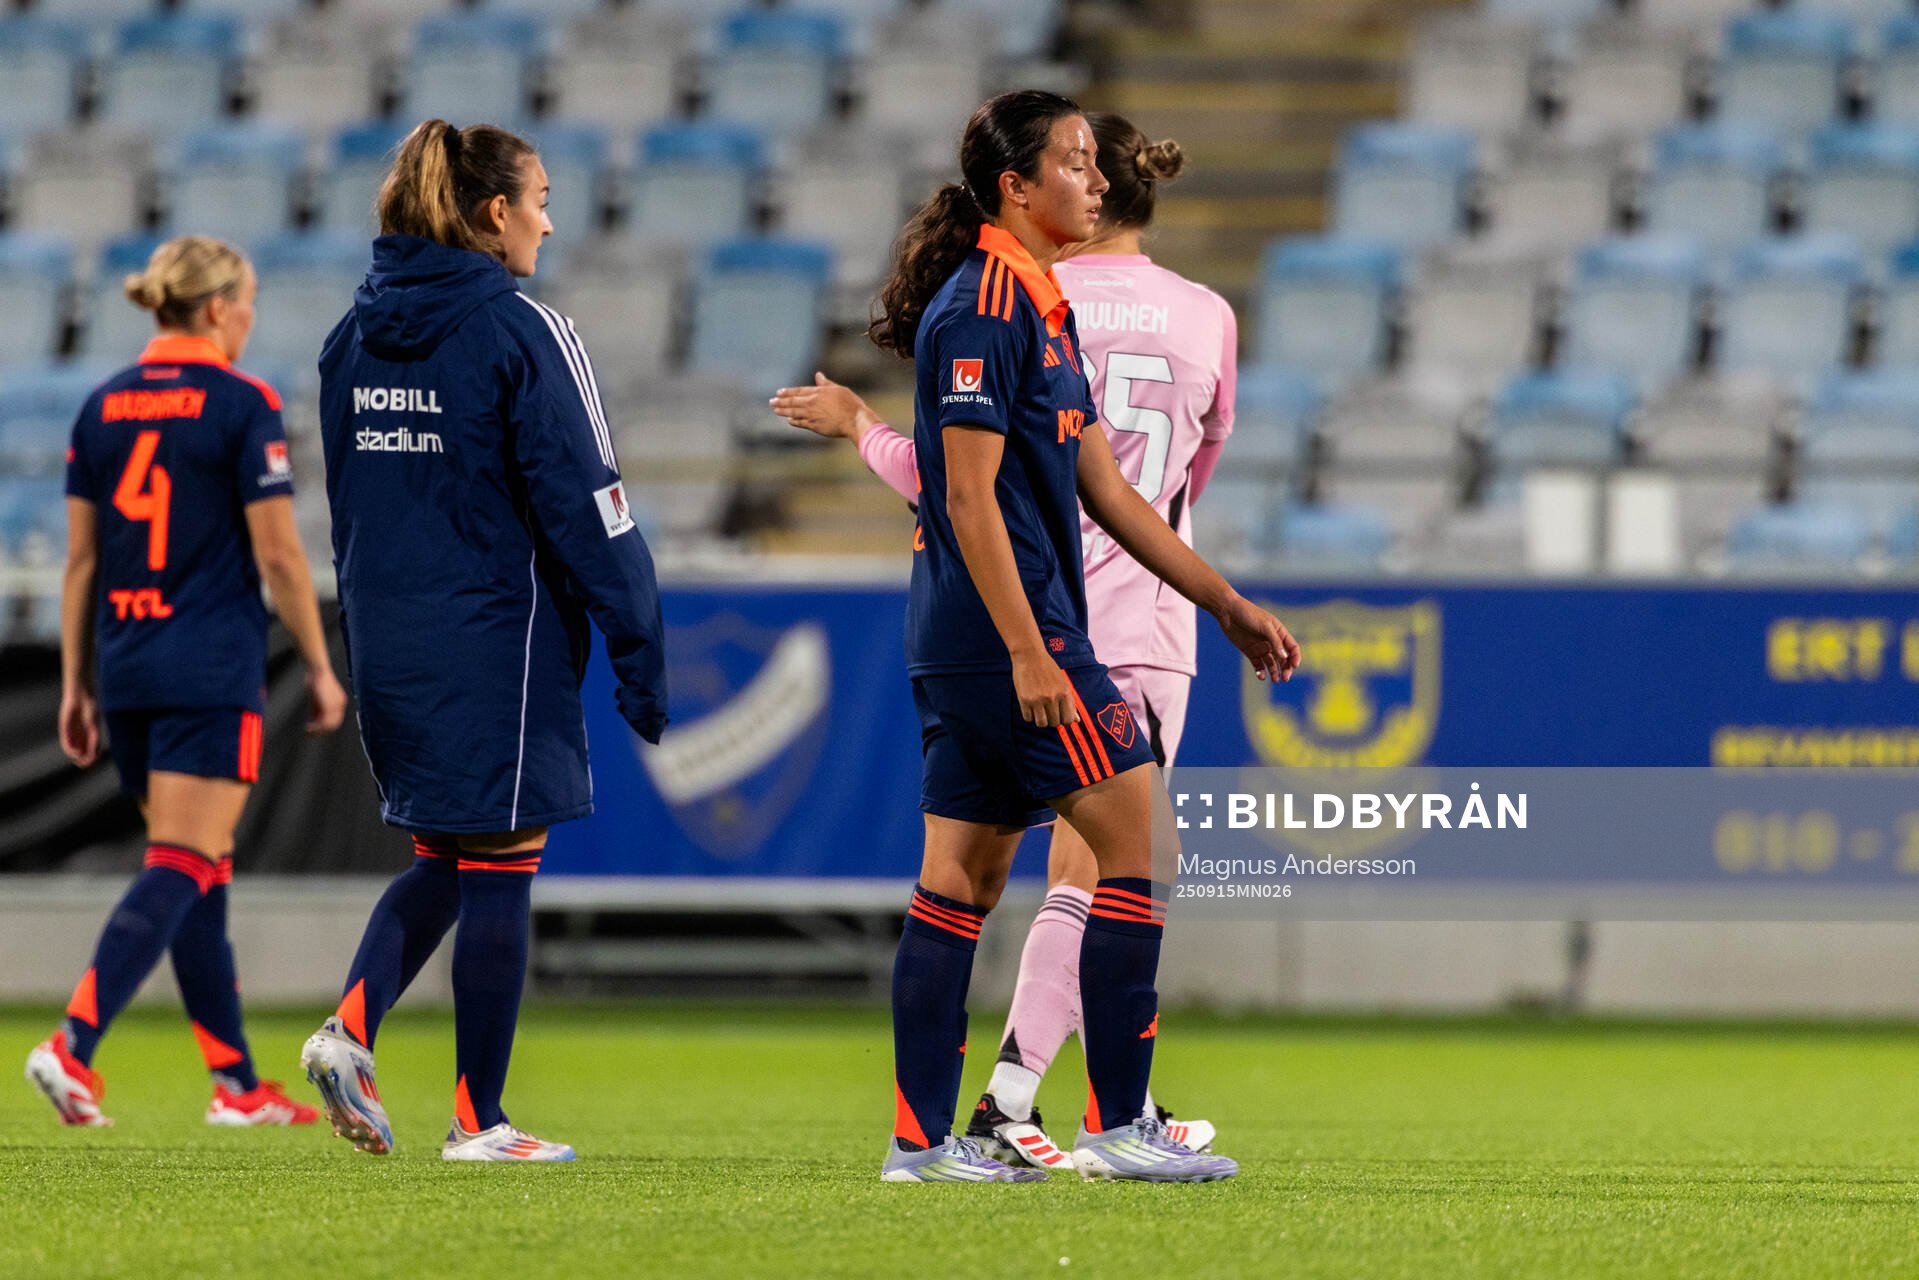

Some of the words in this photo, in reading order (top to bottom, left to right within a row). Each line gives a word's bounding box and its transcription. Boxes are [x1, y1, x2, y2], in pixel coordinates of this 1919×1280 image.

[353, 387, 442, 414] MOBILL
[975, 395, 993, 406] SPEL
[356, 426, 443, 453] stadium
[113, 430, 173, 572] 4
[109, 587, 174, 621] TCL
